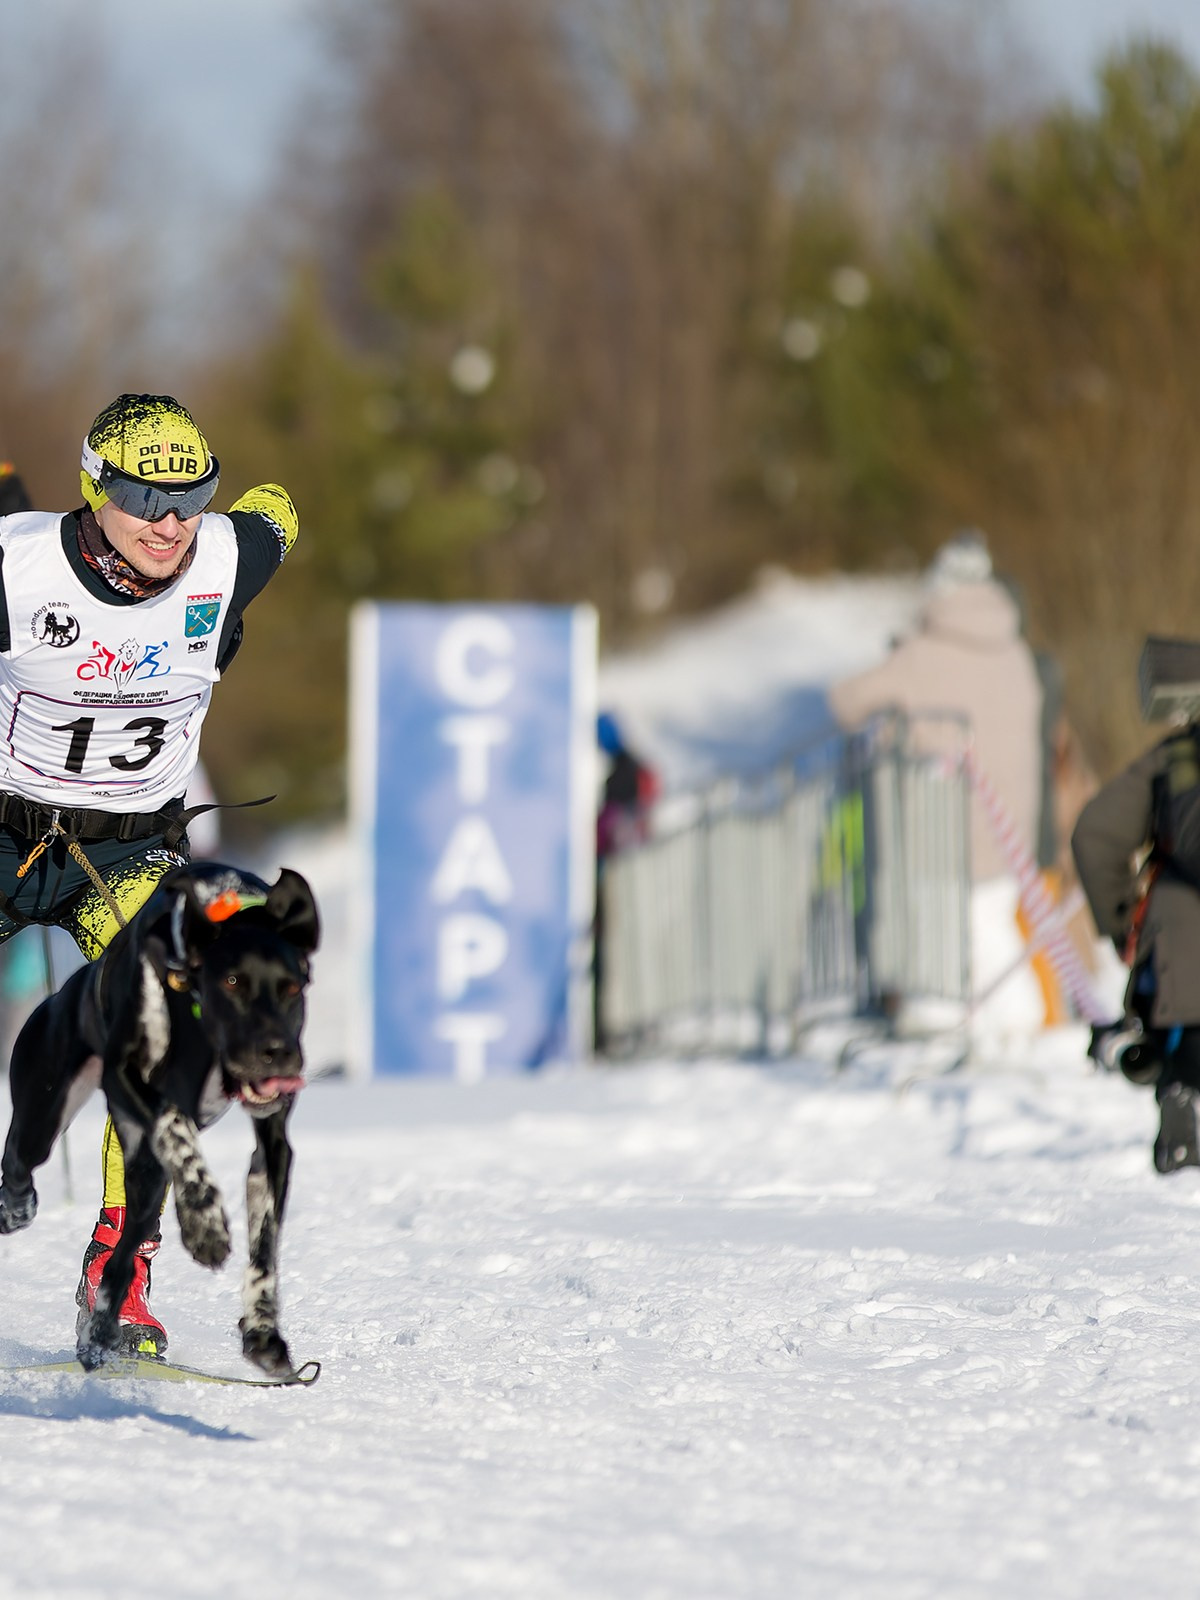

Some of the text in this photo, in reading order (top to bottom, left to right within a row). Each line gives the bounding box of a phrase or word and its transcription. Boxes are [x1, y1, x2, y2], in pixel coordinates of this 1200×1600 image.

[137, 457, 198, 477] CLUB
[31, 601, 70, 639] moondog team
[73, 690, 112, 699] ФЕДЕРАЦИЯ
[146, 690, 169, 698] СПОРТА
[52, 717, 169, 774] 13
[431, 612, 514, 1087] СТАРТ
